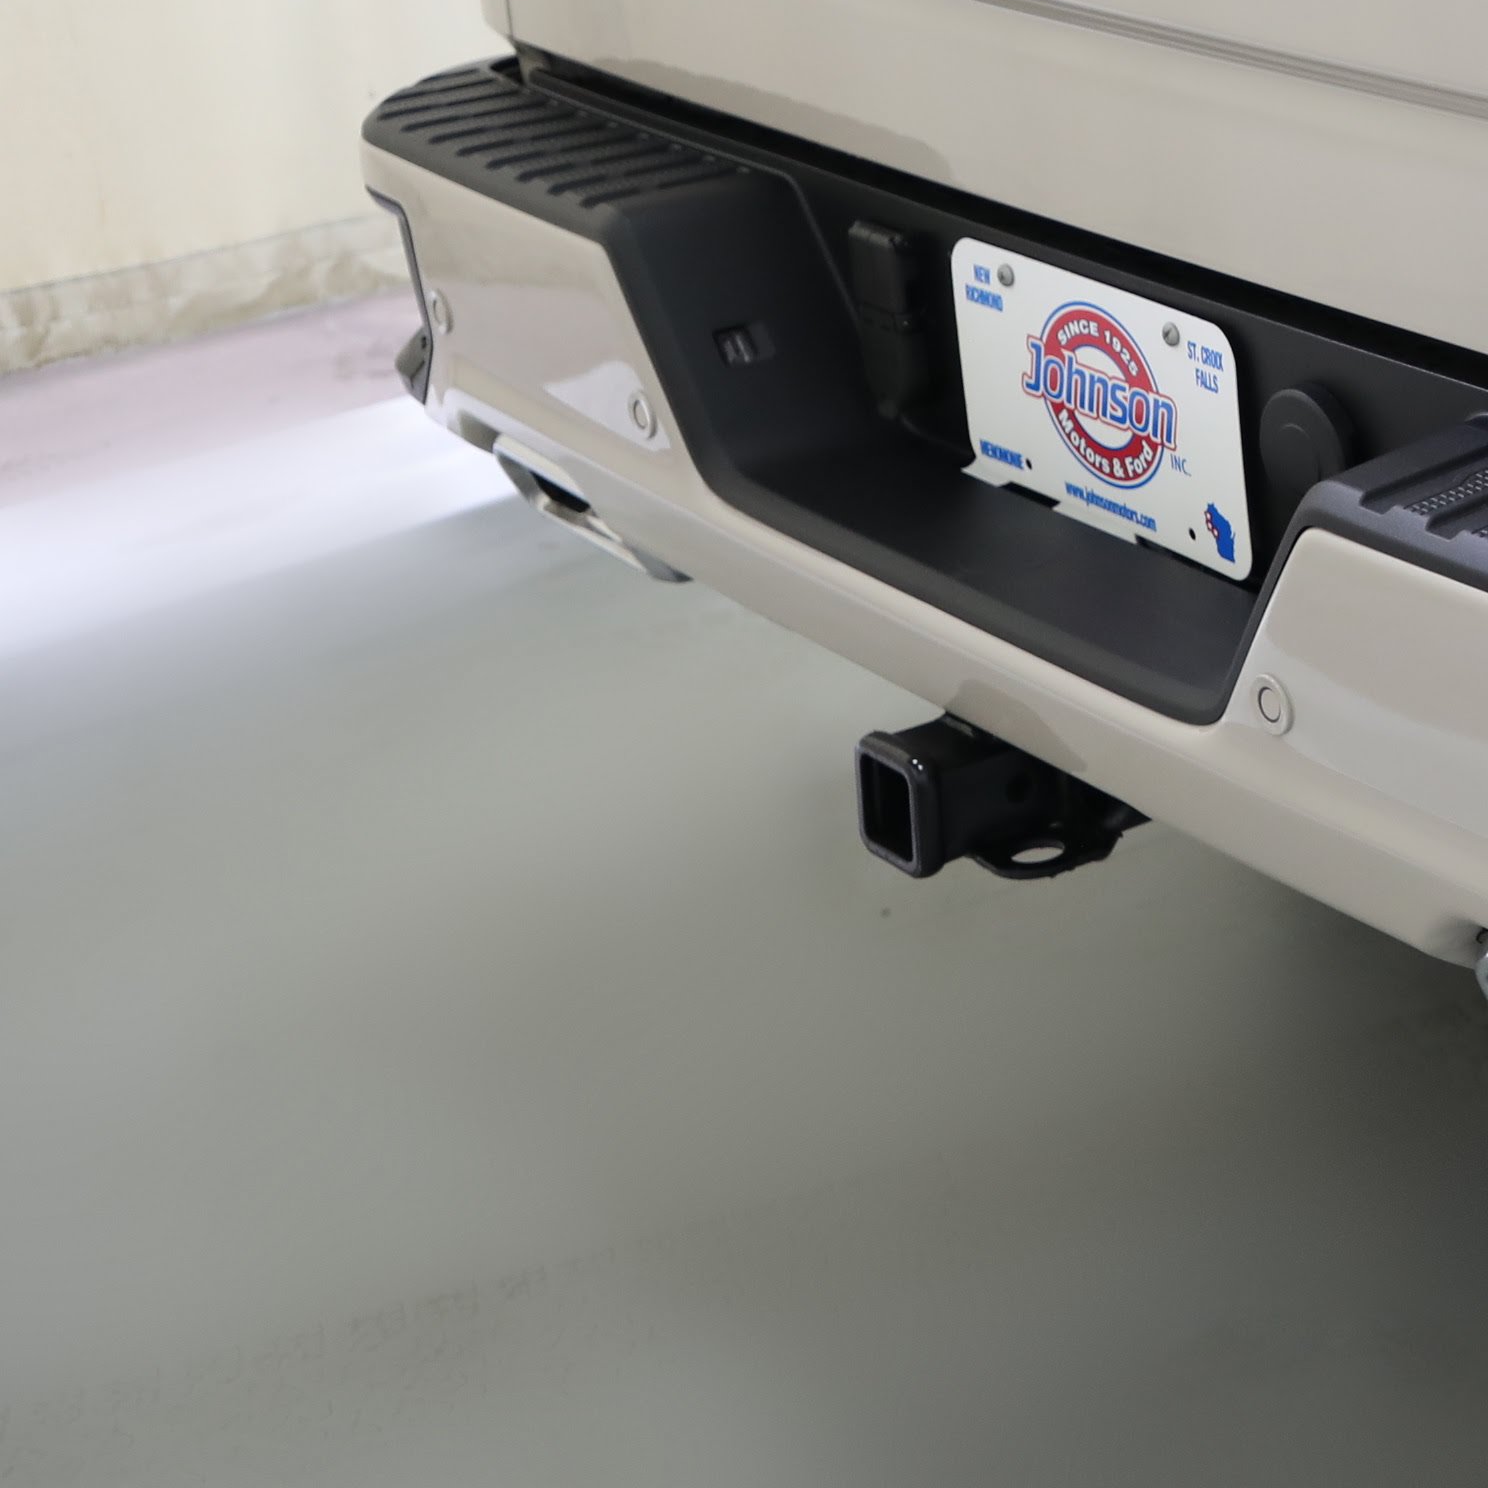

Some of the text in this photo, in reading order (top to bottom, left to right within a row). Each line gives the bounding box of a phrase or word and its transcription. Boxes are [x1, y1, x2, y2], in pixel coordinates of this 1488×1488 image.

[973, 264, 991, 285] NEW
[1057, 319, 1140, 377] SINCE 1925
[1186, 340, 1224, 372] ST. CROIX
[1024, 337, 1176, 447] Johnson
[1195, 368, 1219, 394] FALLS
[1057, 409, 1154, 479] Motors & Ford
[1170, 453, 1192, 477] INC.
